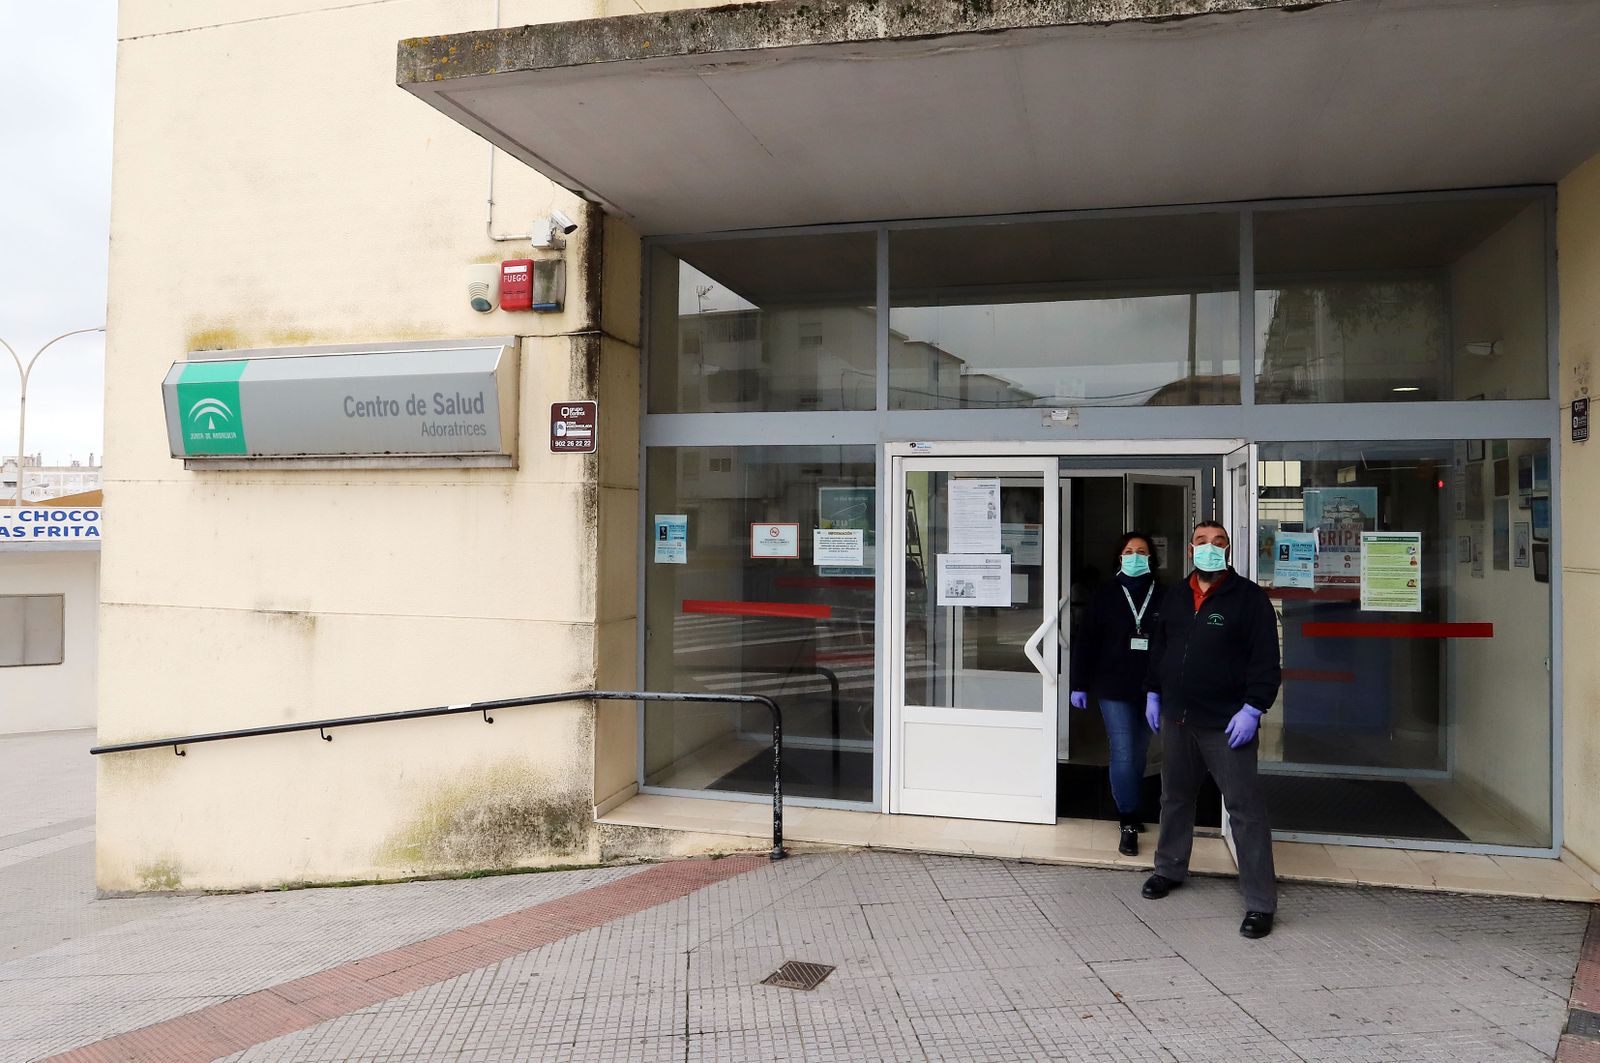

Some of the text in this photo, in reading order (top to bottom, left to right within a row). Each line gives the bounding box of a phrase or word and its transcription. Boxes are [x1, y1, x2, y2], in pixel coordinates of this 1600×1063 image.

[503, 273, 528, 283] FUEGO
[343, 391, 485, 418] Centro de Salud
[421, 420, 487, 437] Adoratrices
[190, 432, 204, 440] JUNTA
[205, 432, 212, 440] DE
